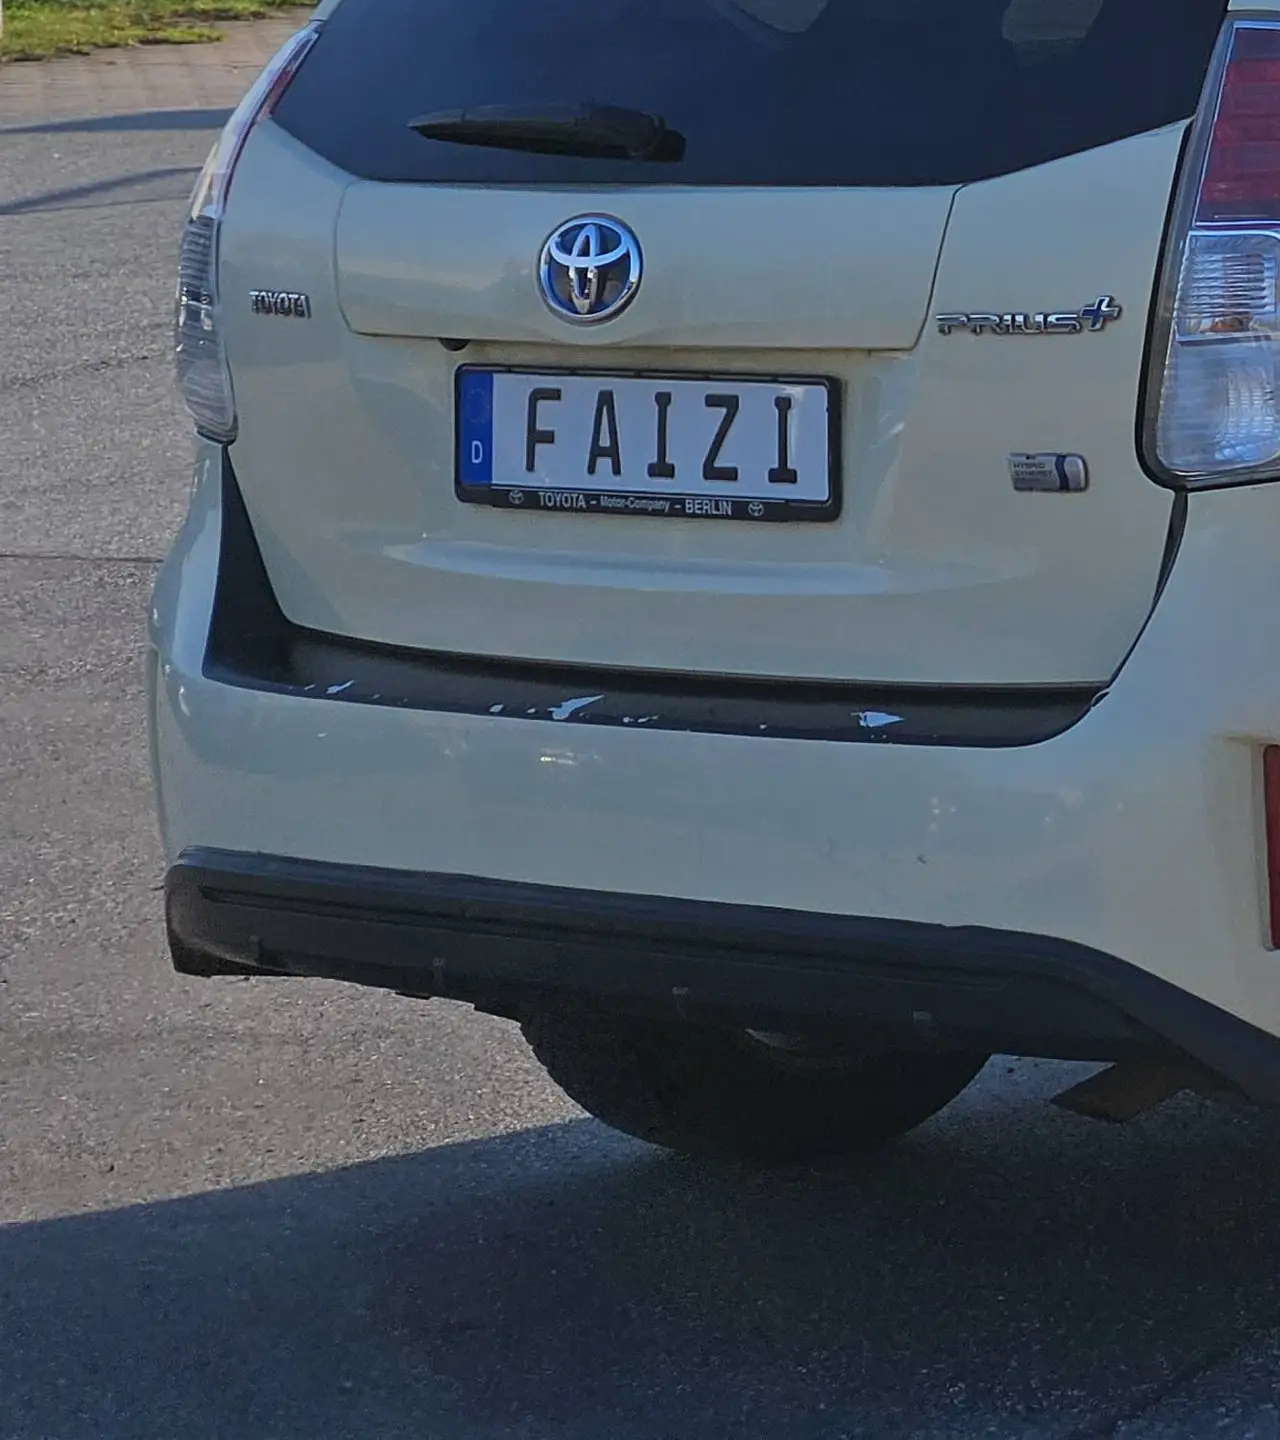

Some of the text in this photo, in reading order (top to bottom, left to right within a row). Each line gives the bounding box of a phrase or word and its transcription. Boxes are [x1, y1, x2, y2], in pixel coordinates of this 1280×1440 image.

[525, 387, 798, 484] FAIZI
[471, 440, 484, 464] D
[538, 491, 587, 510] TOYOTA
[600, 495, 669, 514] Motor-Company
[684, 499, 733, 516] BERLIN
